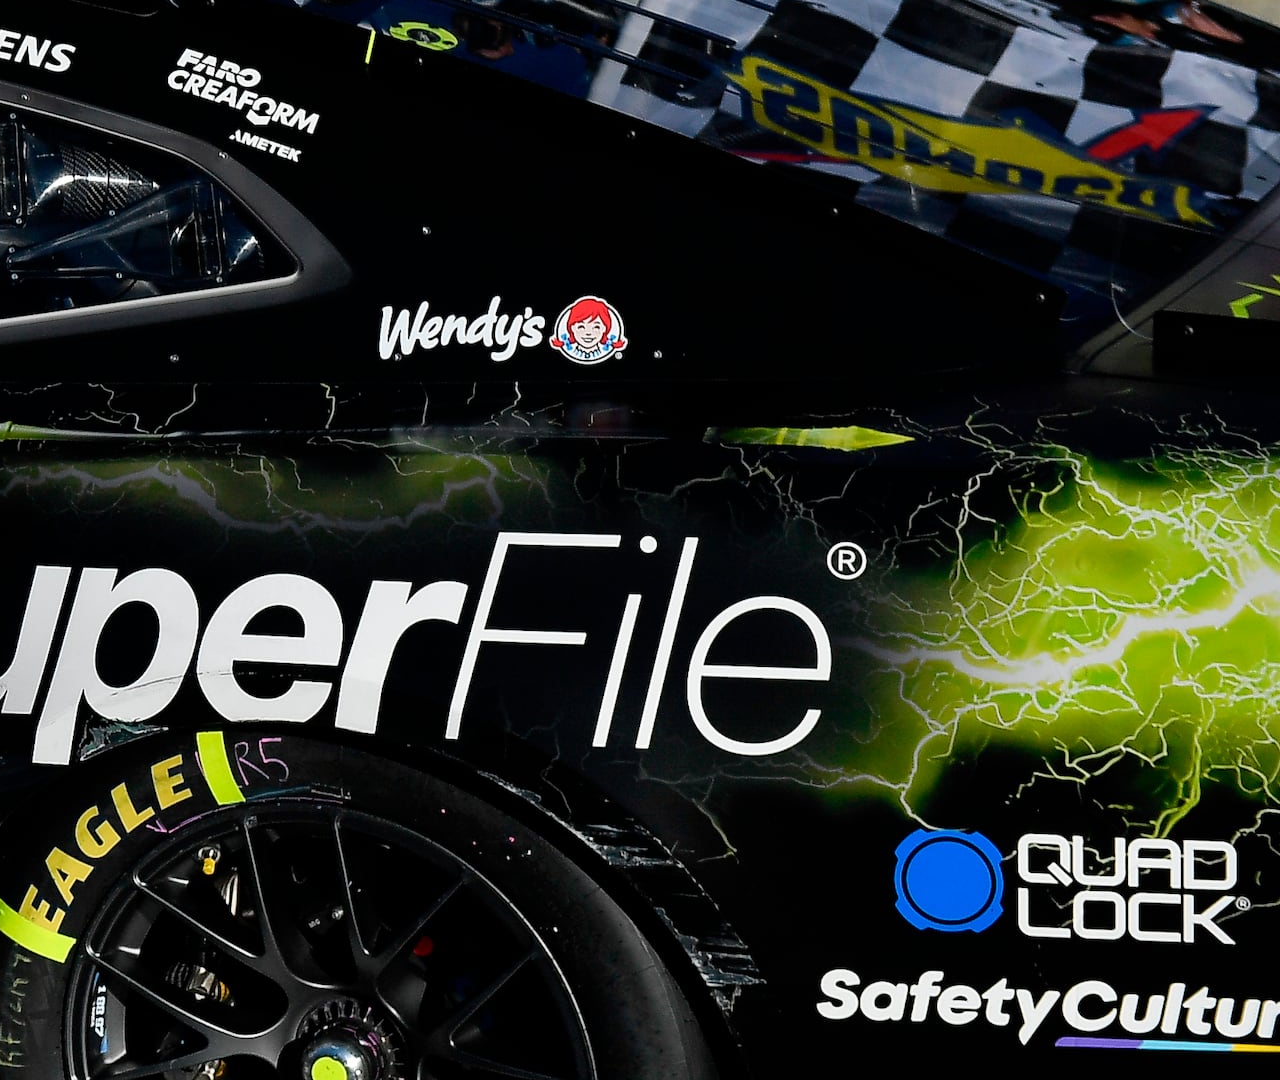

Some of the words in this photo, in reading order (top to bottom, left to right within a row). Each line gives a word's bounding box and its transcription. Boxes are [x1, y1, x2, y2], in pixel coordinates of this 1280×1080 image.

[176, 47, 262, 88] FARO
[167, 69, 320, 135] CREAFORM
[228, 129, 303, 163] AMETEK
[379, 295, 546, 362] Wendy's
[17, 753, 193, 934] EAGLE
[1017, 832, 1238, 891] QUAD
[1017, 887, 1238, 945] LOCK
